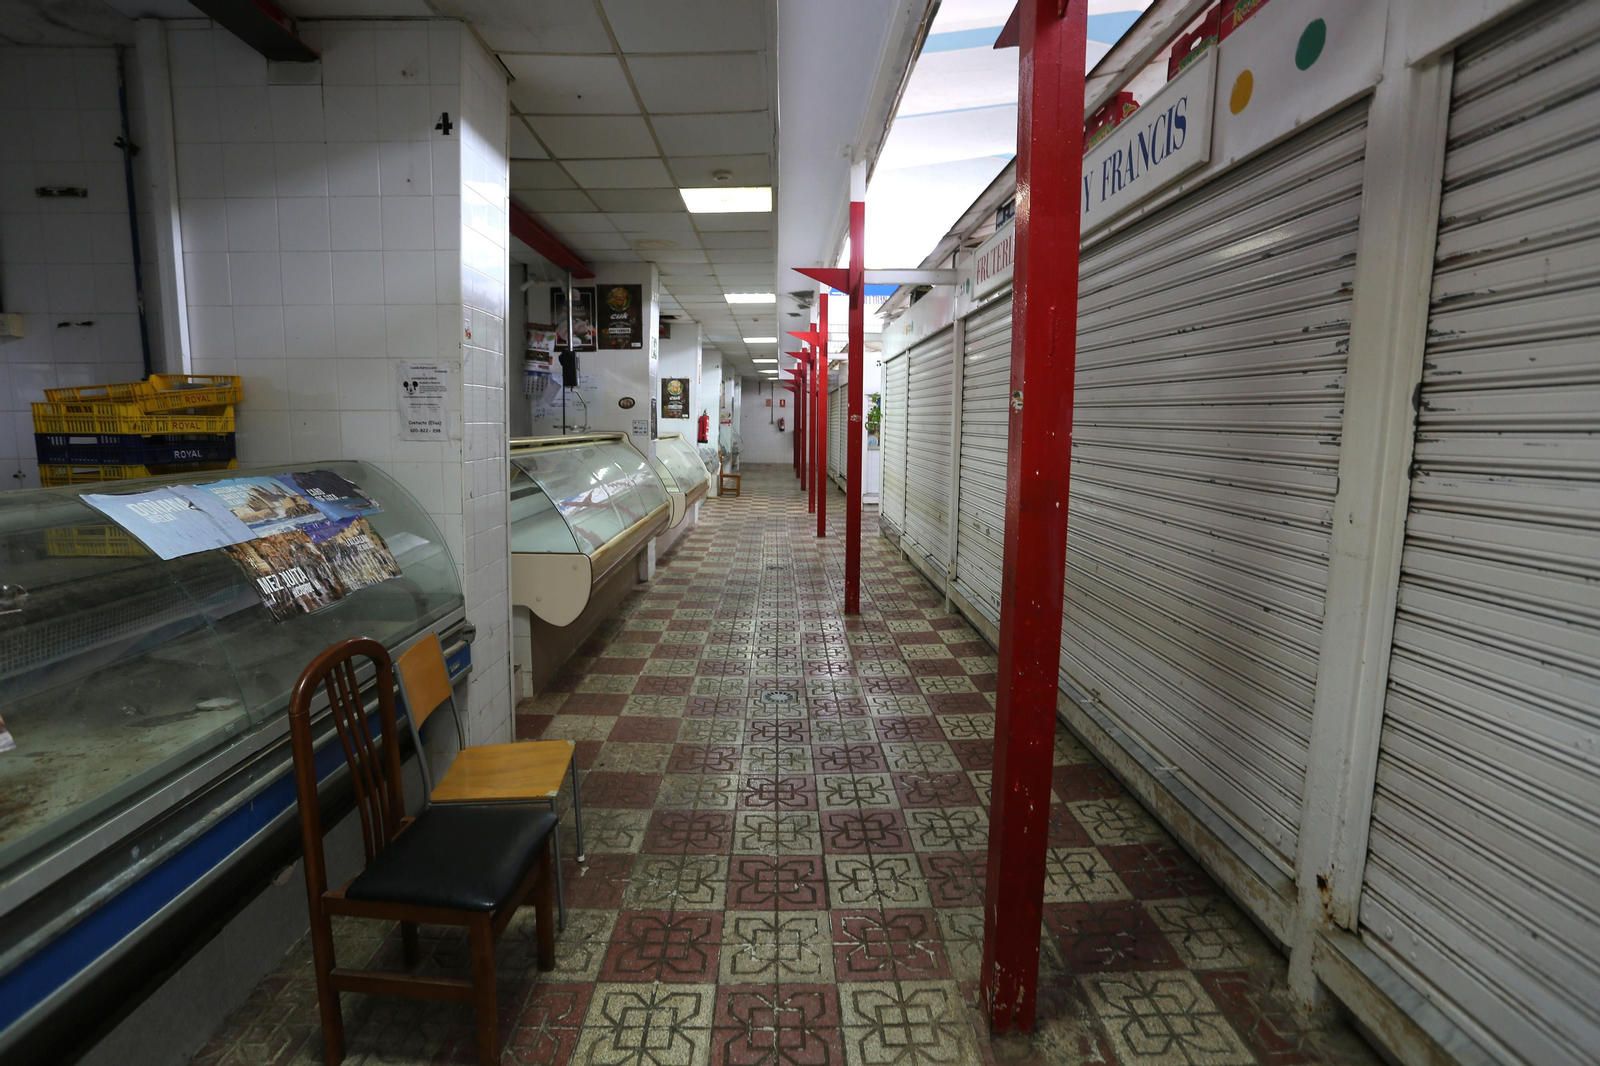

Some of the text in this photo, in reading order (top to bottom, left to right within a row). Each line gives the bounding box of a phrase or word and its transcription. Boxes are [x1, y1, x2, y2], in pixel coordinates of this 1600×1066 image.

[434, 112, 453, 136] 4
[1101, 94, 1188, 203] FRANCIS
[976, 235, 1014, 286] FRUTERI
[185, 394, 212, 404] ROYAL
[172, 421, 201, 430] ROYAL
[174, 450, 203, 459] ROYAL
[144, 513, 179, 524] HUELVA
